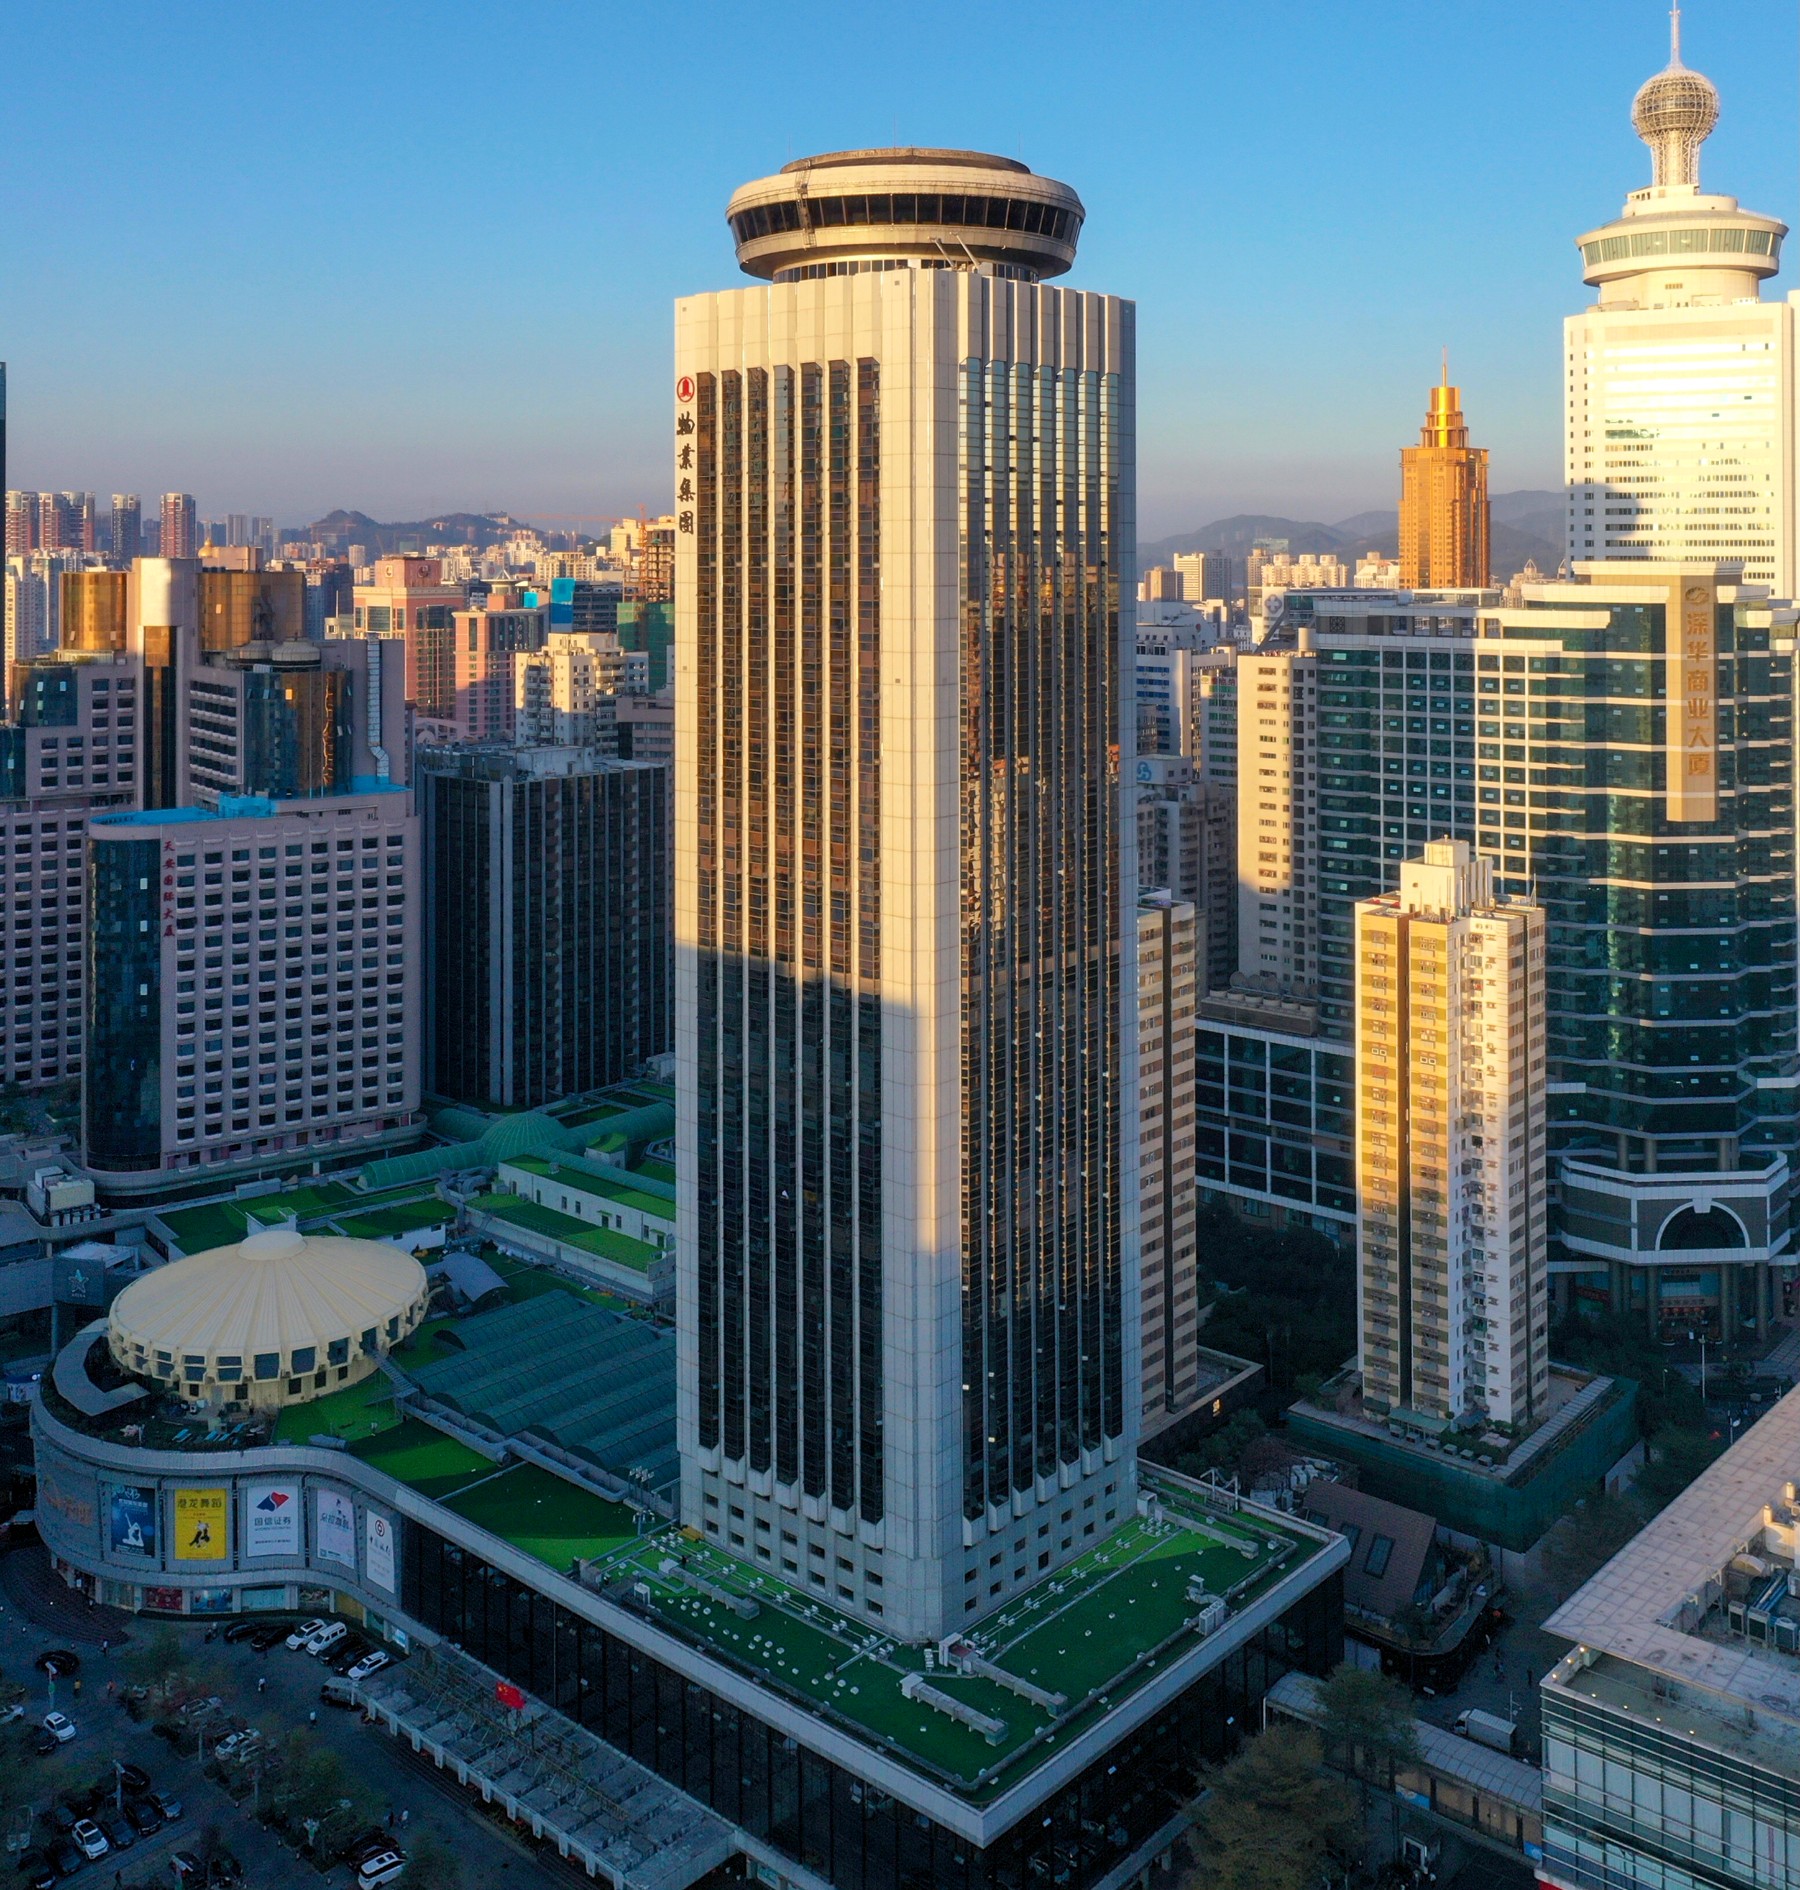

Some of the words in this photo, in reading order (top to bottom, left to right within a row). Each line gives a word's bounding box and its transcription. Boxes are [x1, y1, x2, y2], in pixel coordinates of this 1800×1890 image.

[1687, 612, 1710, 776] 深华商业大厦
[254, 1516, 291, 1527] 国信证券
